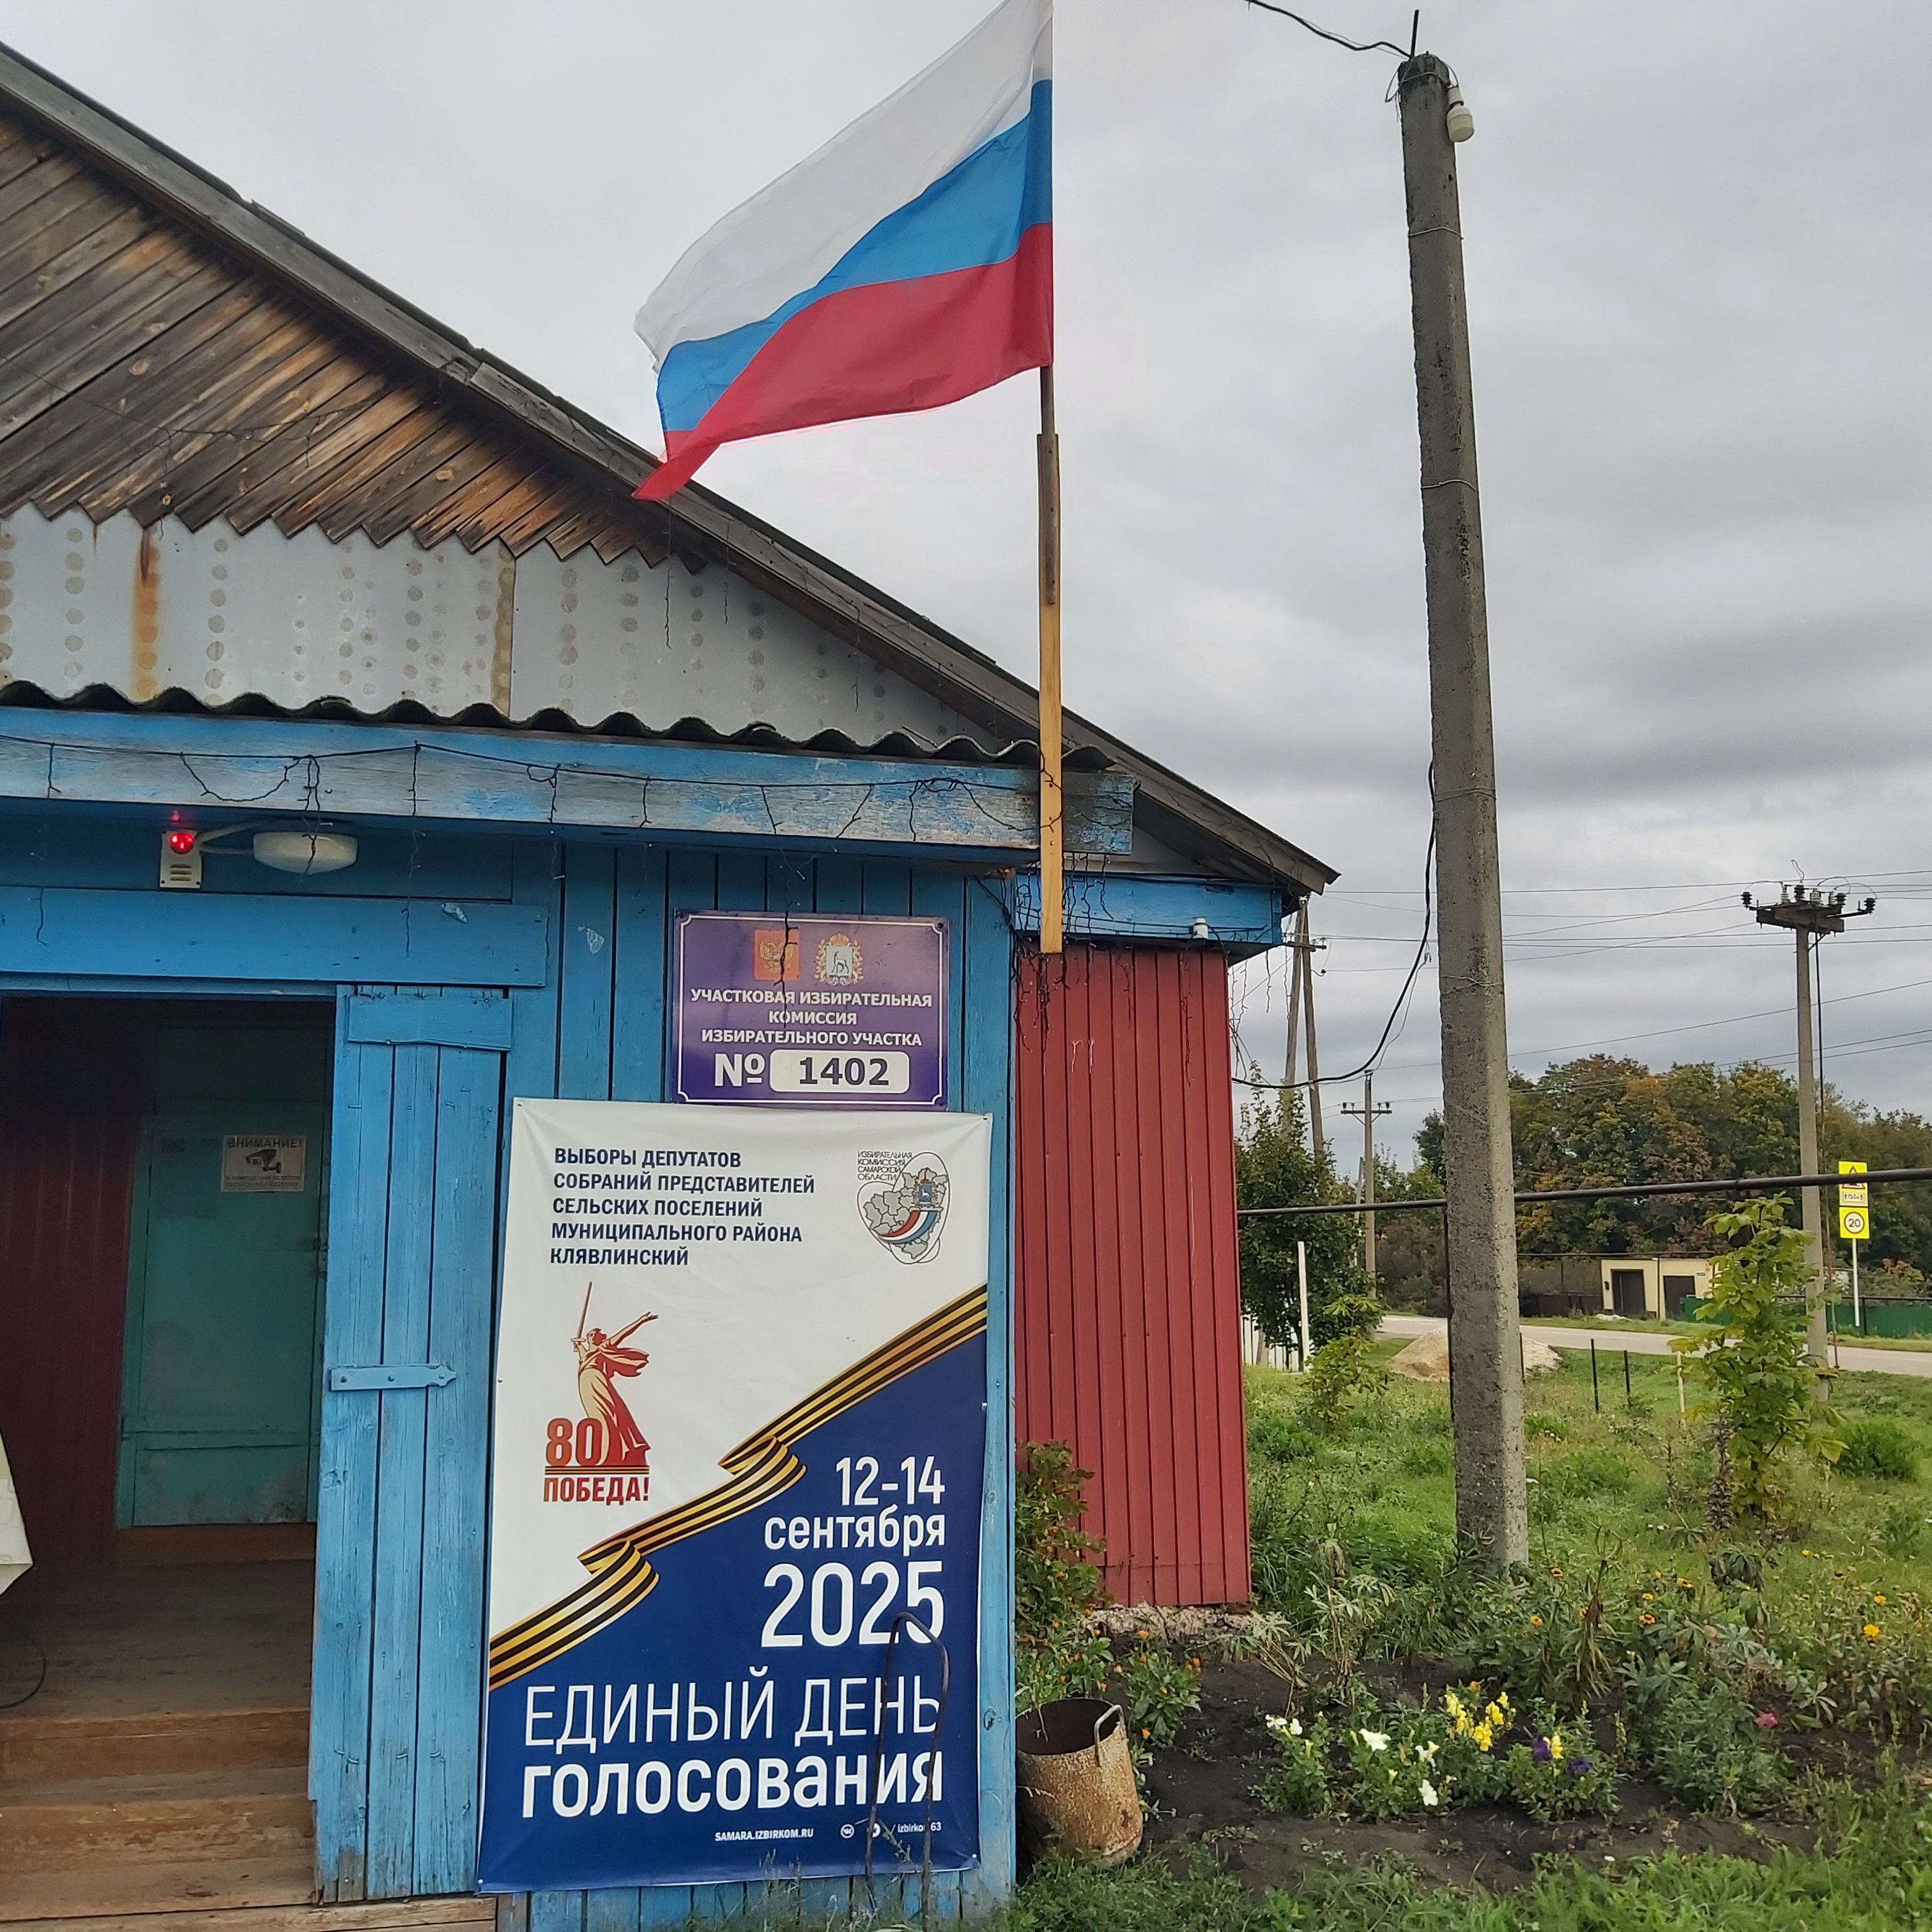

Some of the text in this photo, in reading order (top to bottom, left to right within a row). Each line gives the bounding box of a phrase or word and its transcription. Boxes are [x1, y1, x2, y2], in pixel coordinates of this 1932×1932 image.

[691, 988, 933, 1008] УЧАСТКОВАЯ ИЗБИРАТЕЛЬНАЯ
[769, 1010, 857, 1025] КОМИССИЯ
[702, 1029, 923, 1046] ИЗБИРАТЕЛЬНОГО УЧАСТКА
[714, 1052, 890, 1087] № 1402
[227, 1138, 301, 1148] ВНИМАНИЕ!
[555, 1147, 741, 1169] ВЫБОРЫ ДЕПУТАТОВ
[553, 1170, 815, 1194] СОБРАНИЙ ПРЕДСТАВИТЕЛЕЙ
[553, 1197, 762, 1217] СЕЛЬСКИХ ПОСЕЛЕНИЙ
[551, 1222, 803, 1243] МУНИЦИПАЛЬНОГО РАЙОНА
[1848, 1218, 1861, 1227] 20
[550, 1245, 689, 1266] КЛЯВЛИНСКИЙ
[546, 1417, 603, 1466] 80
[544, 1476, 650, 1506] ПОБЕДА!
[836, 1455, 946, 1506] 12-14
[764, 1503, 946, 1557] сентября
[761, 1560, 944, 1648] 2025
[525, 1666, 940, 1754] ЕДИНЫЙ ДЕНЬ
[715, 1828, 814, 1841] SAMARA.IZBIRKOM.RU
[897, 1821, 942, 1833] izbirko63
